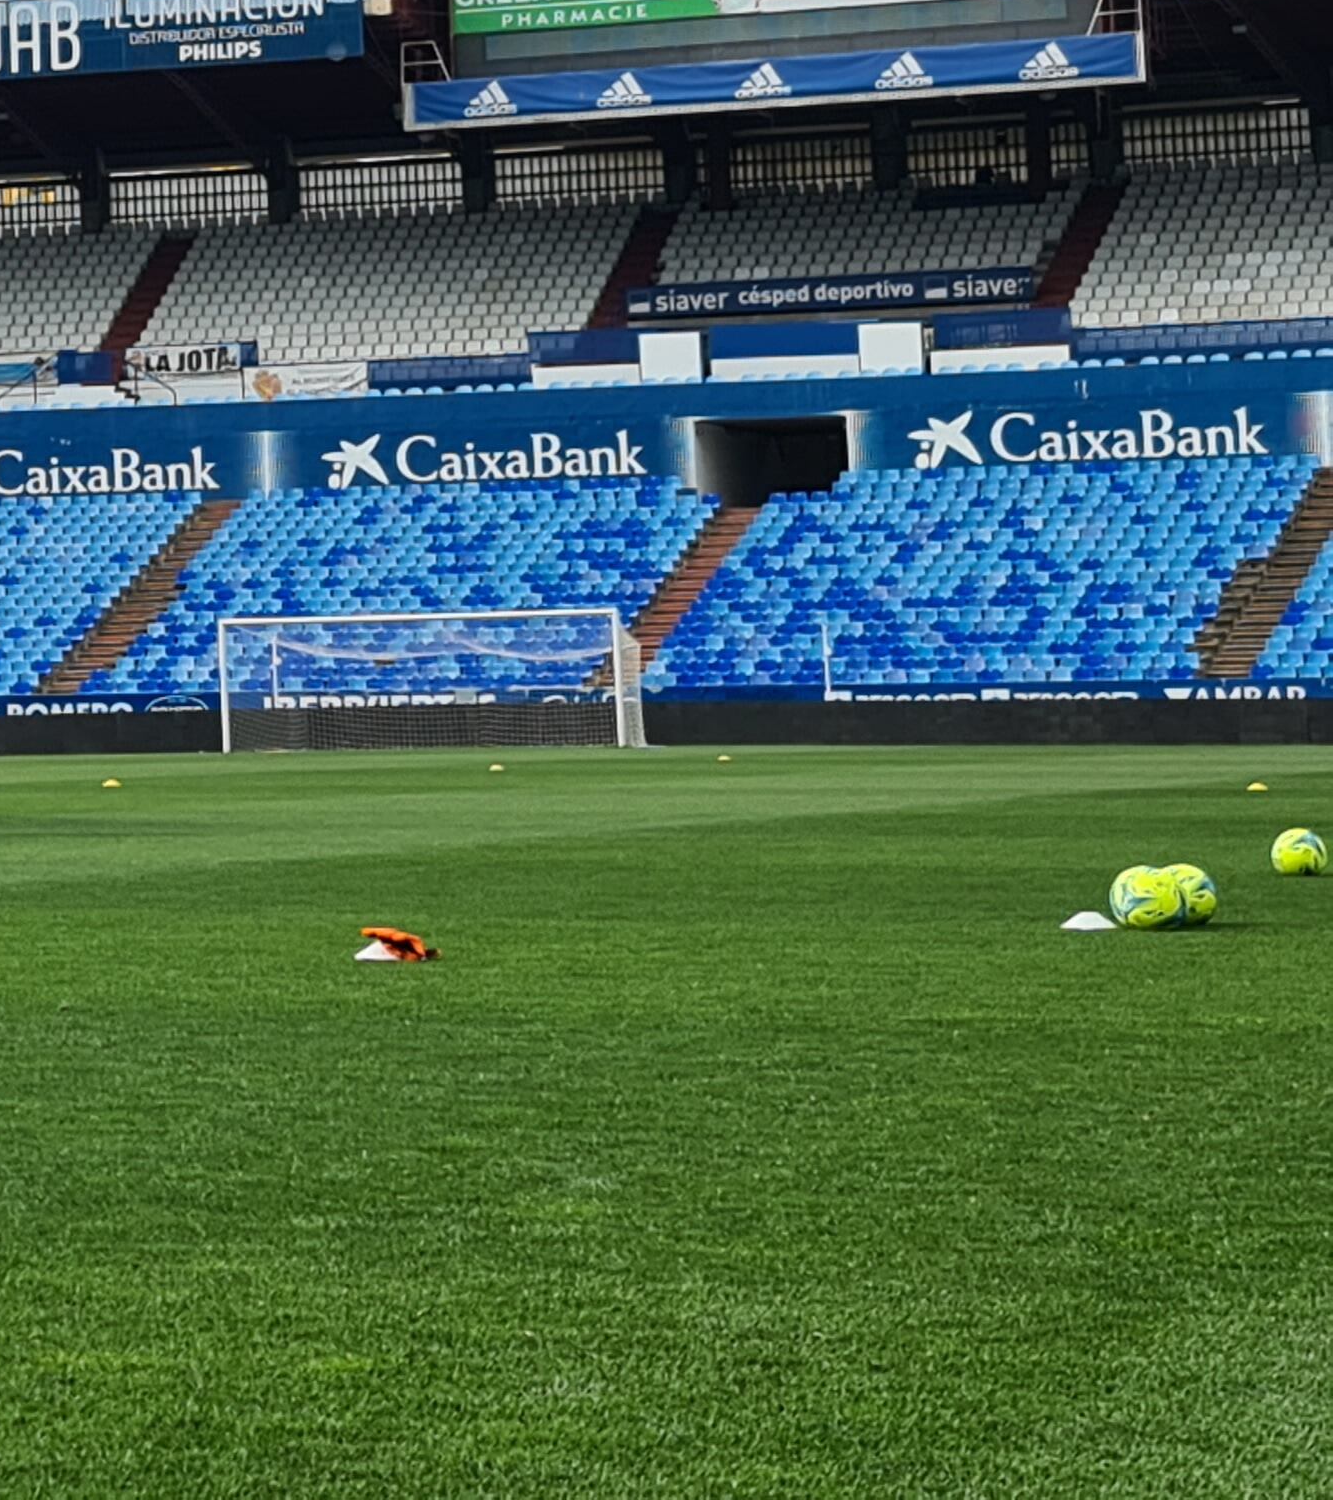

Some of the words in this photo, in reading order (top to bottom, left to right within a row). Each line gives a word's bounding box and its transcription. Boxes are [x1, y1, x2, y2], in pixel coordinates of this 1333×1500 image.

[501, 3, 648, 28] PHARMACIE
[179, 41, 263, 62] PHILIPS
[874, 75, 934, 90] adidas
[1018, 66, 1080, 80] adidas
[596, 94, 652, 108] adidas
[735, 85, 793, 100] adidas
[464, 103, 517, 118] adidas
[654, 288, 730, 312] siaver
[737, 285, 810, 308] césped
[814, 279, 915, 306] deportivo
[144, 354, 171, 373] LA
[177, 346, 229, 372] JOTA
[989, 407, 1270, 463] CaixaBank
[395, 429, 647, 483] CaixaBank
